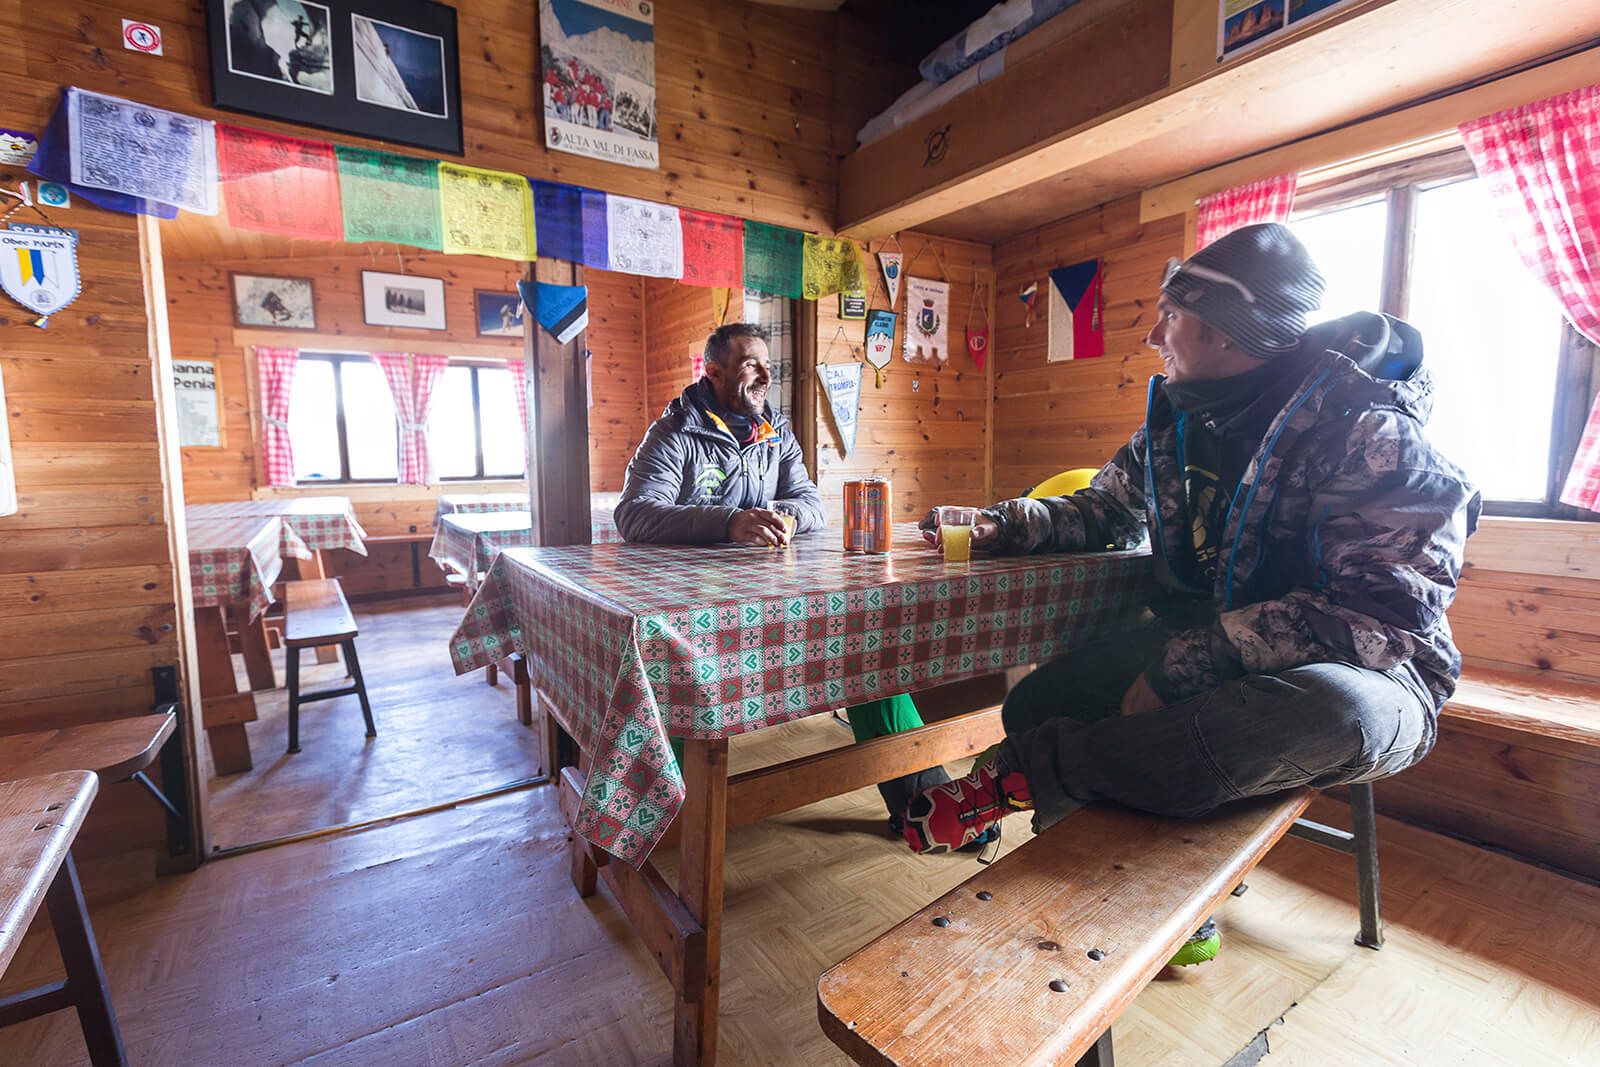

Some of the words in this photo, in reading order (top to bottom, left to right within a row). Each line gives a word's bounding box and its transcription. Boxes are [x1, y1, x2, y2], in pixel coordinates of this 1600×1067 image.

[563, 133, 590, 148] ALTA
[593, 139, 610, 151] VAL
[614, 144, 625, 154] DI
[627, 147, 655, 162] FASSA
[173, 364, 215, 375] anna
